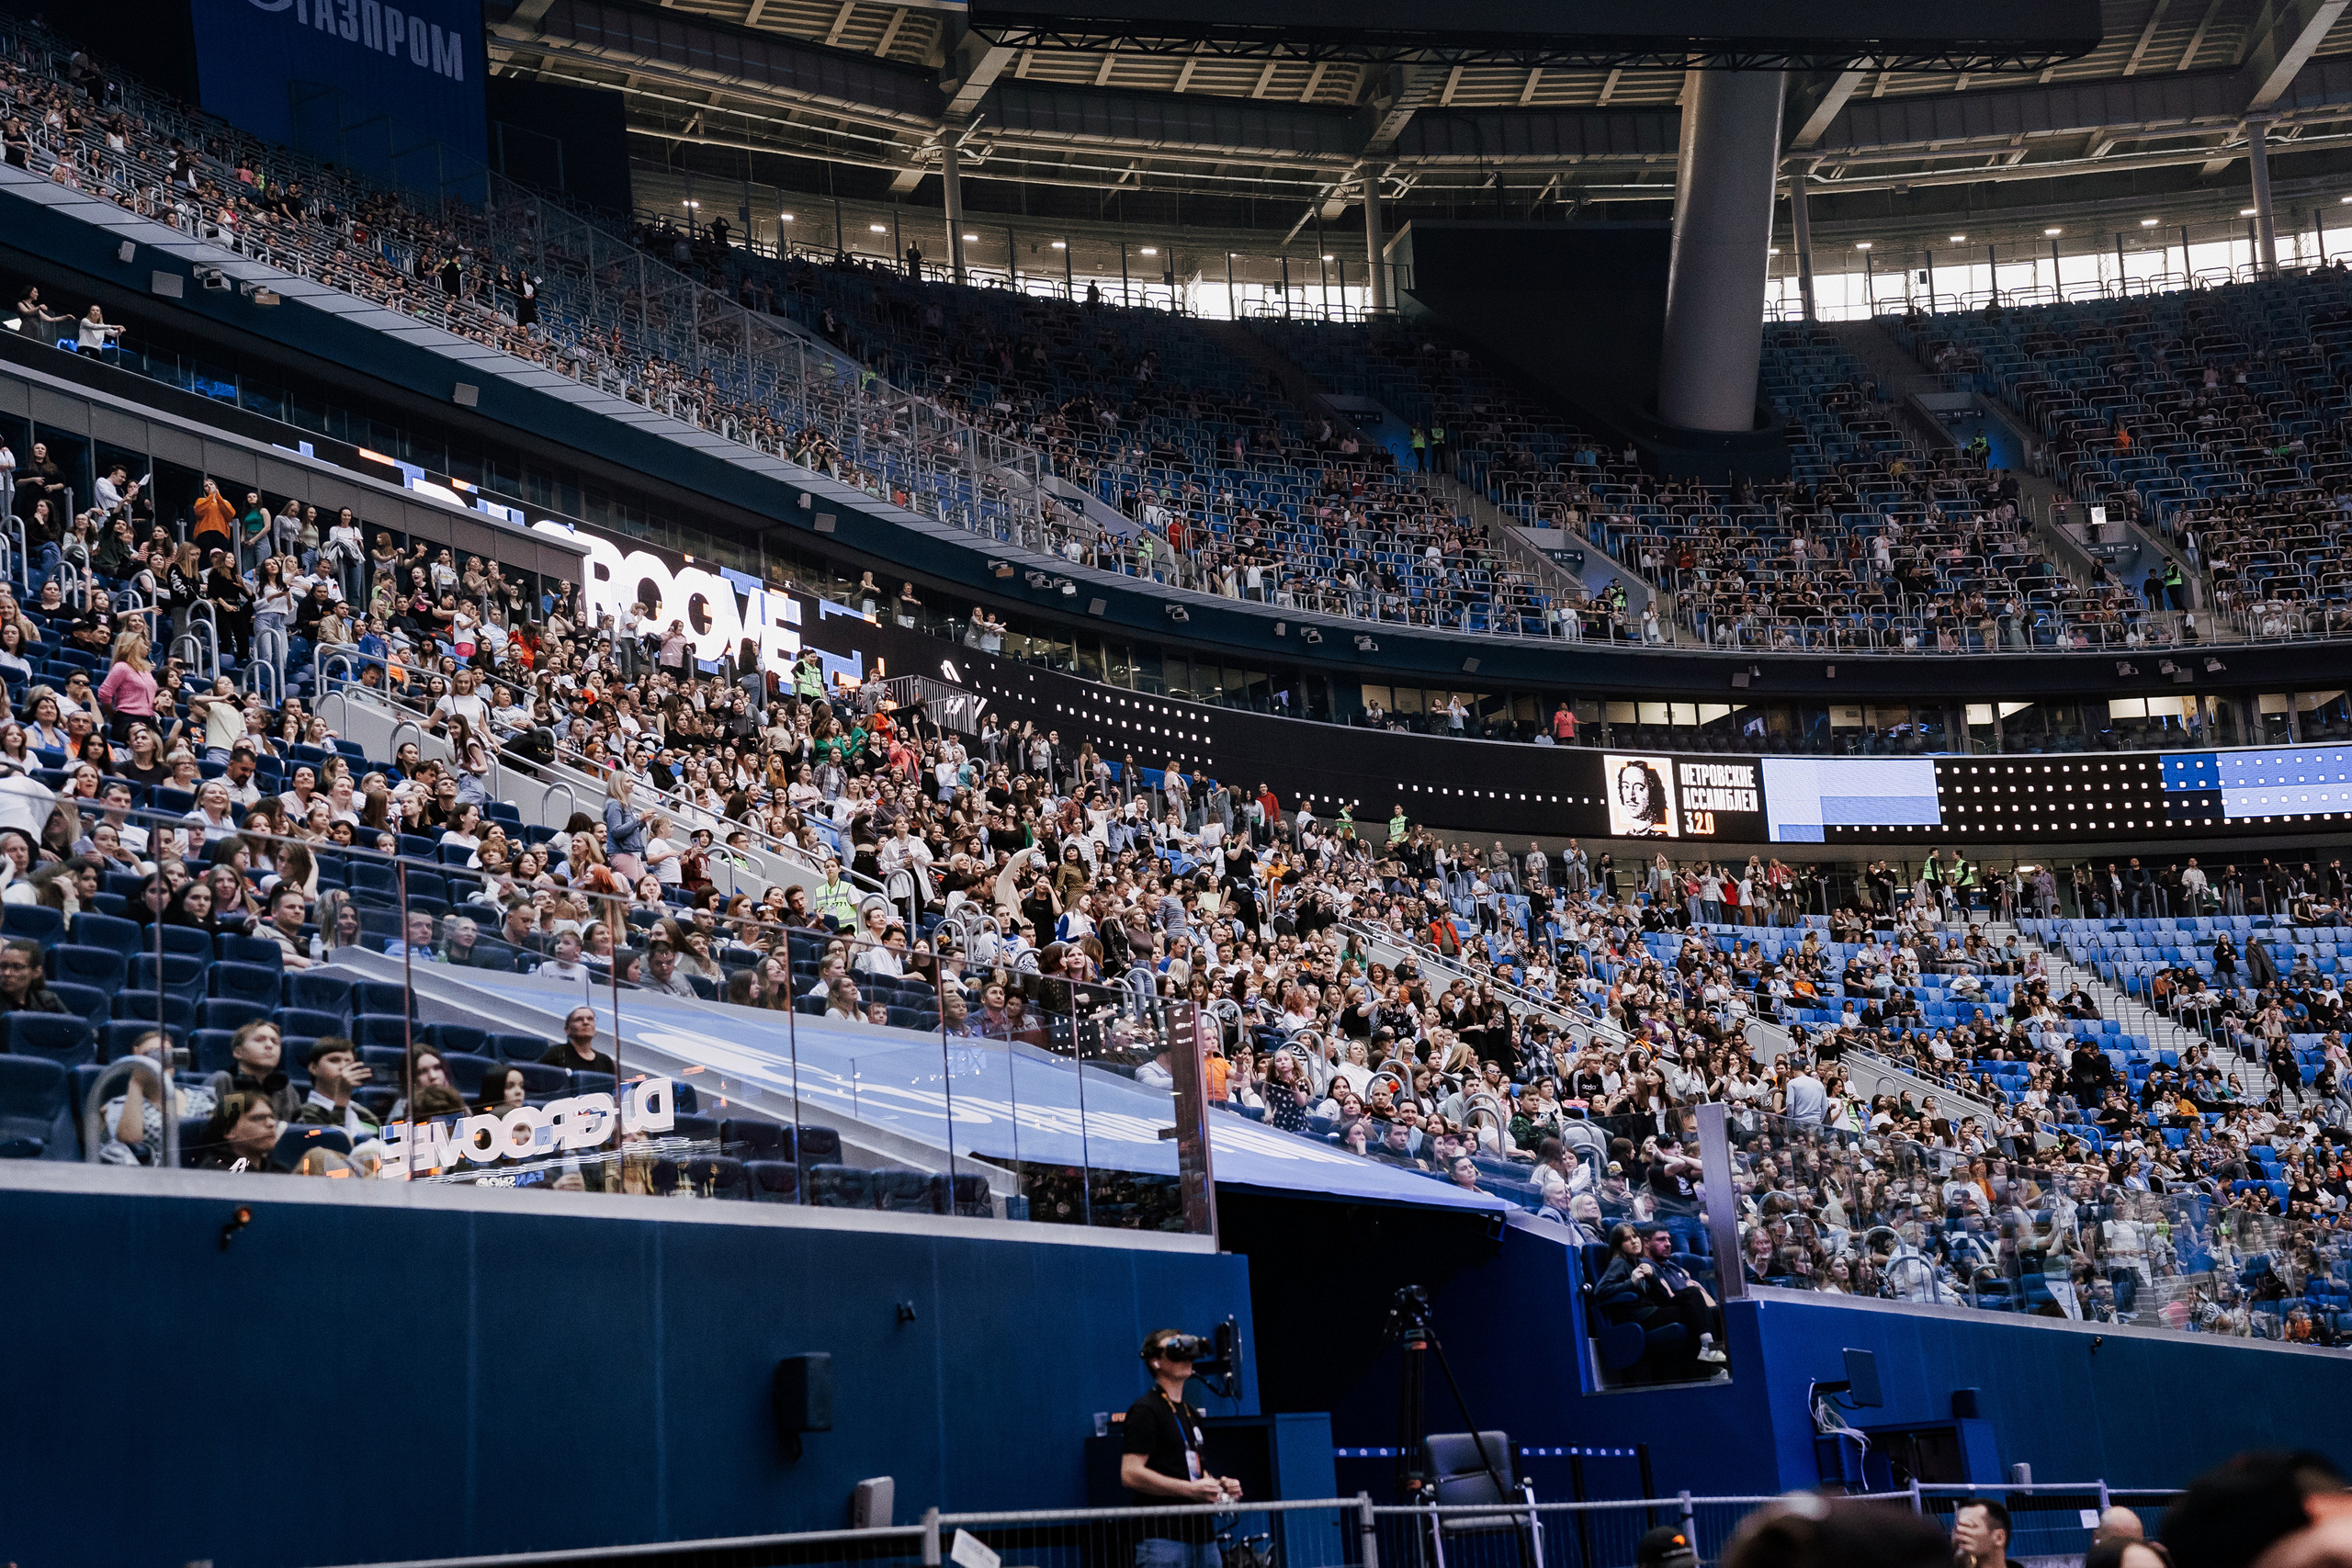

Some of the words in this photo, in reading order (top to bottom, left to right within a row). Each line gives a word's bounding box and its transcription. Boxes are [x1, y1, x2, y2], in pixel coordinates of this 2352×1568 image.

[531, 520, 802, 685] ROOVE
[1679, 763, 1756, 787] ПЕТРОВСКИЕ
[1682, 787, 1758, 812] АССАМБЛЕИ
